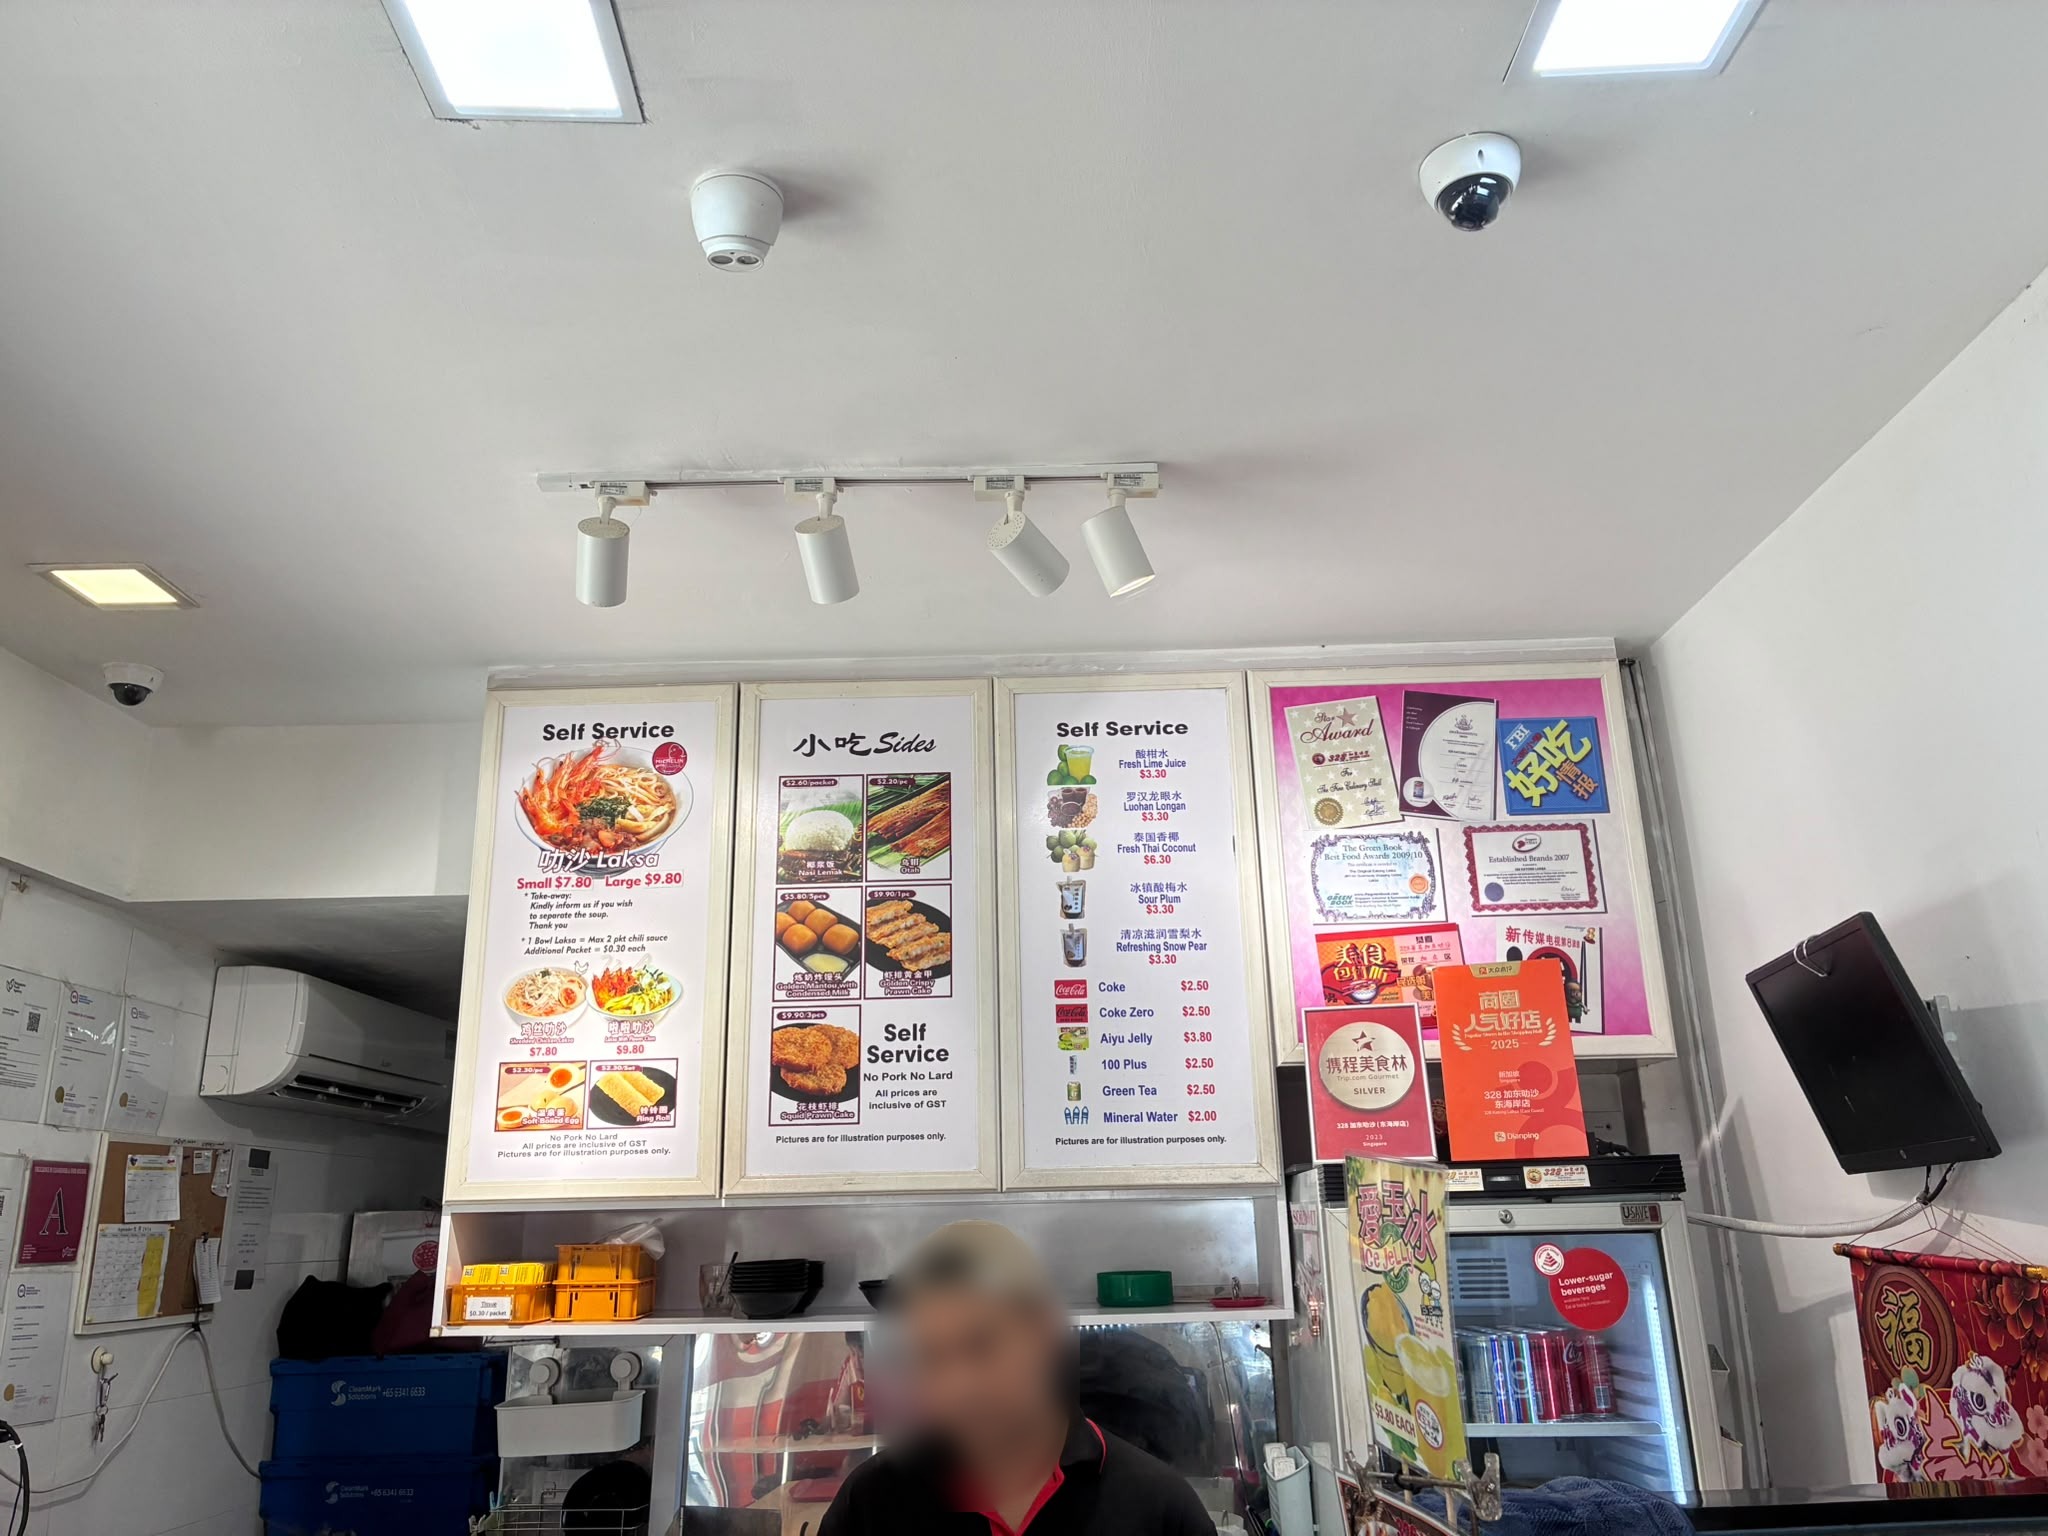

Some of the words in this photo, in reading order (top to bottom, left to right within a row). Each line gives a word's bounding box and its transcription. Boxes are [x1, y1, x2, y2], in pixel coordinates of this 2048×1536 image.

[542, 723, 585, 741] Self
[592, 721, 675, 739] Service
[1056, 722, 1099, 737] Self
[1106, 721, 1189, 736] Service
[1300, 718, 1375, 744] Award
[1506, 724, 1530, 750] FBI
[793, 732, 872, 757] 小吃
[873, 731, 937, 754] Sides
[1135, 748, 1169, 759] 酸柑水
[1119, 759, 1142, 768] Fresh
[1143, 759, 1163, 768] Lime
[1164, 759, 1186, 768] Juice
[1505, 719, 1592, 807] 好吃
[1139, 769, 1167, 779] $3.30
[1555, 759, 1598, 800] 情报
[1126, 791, 1183, 802] 罗汉龙眼水
[1124, 802, 1154, 811] Luohan
[1155, 802, 1186, 813] Longan
[1141, 811, 1169, 822] $3.30
[1134, 831, 1180, 843] 泰国香椰
[1117, 844, 1141, 854] Fresh
[1142, 844, 1160, 853] Thai
[1161, 844, 1196, 853] Coconut
[1342, 844, 1358, 852] The
[1359, 844, 1381, 852] Green
[1383, 843, 1403, 851] Book
[538, 849, 591, 874] 叻沙
[596, 850, 660, 869] Laksa
[1143, 854, 1172, 865] $6.30
[1343, 853, 1361, 861] Food
[1391, 852, 1423, 861] 2009/10
[1529, 855, 1553, 863] Brands
[1554, 854, 1570, 862] 2007
[517, 877, 552, 890] Small
[555, 875, 592, 890] $7.80
[605, 876, 641, 889] Large
[645, 872, 682, 887] $9.80
[1130, 882, 1188, 893] 冰镇酸梅水
[530, 892, 572, 901] Take-away:
[1138, 894, 1159, 904] Sour
[1160, 894, 1181, 904] Plum
[530, 901, 553, 911] Kindly
[555, 900, 580, 910] inform
[593, 899, 600, 909] if
[600, 901, 614, 911] you
[616, 900, 633, 908] wish
[1146, 904, 1174, 915] $3.30
[529, 912, 537, 920] to
[539, 912, 573, 921] separate
[574, 911, 587, 919] the
[589, 911, 609, 920] soup.
[529, 921, 552, 930] Thank
[554, 923, 568, 931] you
[1120, 928, 1202, 940] 清凉滋润雪梨水
[524, 946, 564, 955] Additional
[566, 945, 592, 955] Packet
[603, 944, 626, 954] $0.30
[627, 944, 647, 952] each
[1116, 942, 1162, 953] Refreshing
[1163, 942, 1187, 951] Snow
[1188, 941, 1207, 951] Pear
[1148, 954, 1177, 965] $3.30
[1336, 943, 1387, 966] 美食
[1098, 982, 1126, 993] Coke
[1180, 980, 1209, 992] $2.50
[785, 990, 831, 998] Condensed
[832, 989, 850, 997] Milk
[1479, 989, 1520, 1010] 商圈
[1099, 1007, 1127, 1018] Coke
[1129, 1007, 1154, 1018] Zero
[1182, 1006, 1211, 1017] $2.50
[608, 1019, 655, 1035] 啦啦叻沙
[1464, 1010, 1542, 1033] 人气好店
[521, 1021, 567, 1036] 鸡丝叻沙
[883, 1023, 927, 1042] Self
[1100, 1033, 1125, 1046] Aiyu
[1127, 1032, 1153, 1046] Jelly
[1183, 1031, 1212, 1043] $3.80
[1490, 1038, 1519, 1050] 2025
[529, 1046, 558, 1057] $7.80
[616, 1044, 645, 1055] $9.80
[866, 1044, 949, 1065] Service
[1101, 1059, 1120, 1070] 100
[1123, 1058, 1147, 1070] Plus
[1185, 1057, 1214, 1069] $2.50
[1326, 1054, 1408, 1075] 携程美食林
[863, 1072, 879, 1082] No
[881, 1071, 908, 1081] Pork
[910, 1071, 926, 1081] No
[928, 1070, 953, 1080] Lard
[1337, 1074, 1367, 1082] Trip.com
[875, 1088, 889, 1097] All
[891, 1088, 920, 1099] prices
[922, 1089, 938, 1097] are
[1102, 1085, 1136, 1097] Green
[1138, 1085, 1157, 1096] Tea
[1186, 1083, 1215, 1095] $2.50
[1353, 1087, 1386, 1095] SILVER
[1484, 1090, 1502, 1099] 328
[1503, 1089, 1540, 1099] 加东叻沙
[869, 1101, 912, 1110] inclusive
[913, 1100, 925, 1109] of
[926, 1100, 947, 1109] GST
[1495, 1099, 1531, 1109] 东海岸店
[781, 1112, 805, 1121] Squid
[834, 1111, 855, 1119] Cake
[1103, 1112, 1144, 1124] Mineral
[1145, 1112, 1178, 1123] Water
[1188, 1110, 1217, 1122] $2.00
[550, 1134, 561, 1142] No
[599, 1133, 618, 1141] Lard
[776, 1135, 810, 1144] Pictures
[827, 1134, 839, 1142] for
[840, 1133, 885, 1142] illustration
[886, 1133, 926, 1143] purposes
[926, 1132, 947, 1142] only.
[1507, 1131, 1540, 1140] Dianping
[1543, 1168, 1562, 1176] 328
[39, 1187, 69, 1236] A
[1622, 1206, 1649, 1219] U-SAVE
[1558, 1272, 1614, 1287] Lower-sugar
[1560, 1283, 1607, 1297] beverages
[1876, 1286, 1933, 1373] 福
[348, 1385, 381, 1393] CleanMark
[1375, 1402, 1395, 1426] $3.80
[1395, 1413, 1416, 1439] EACH
